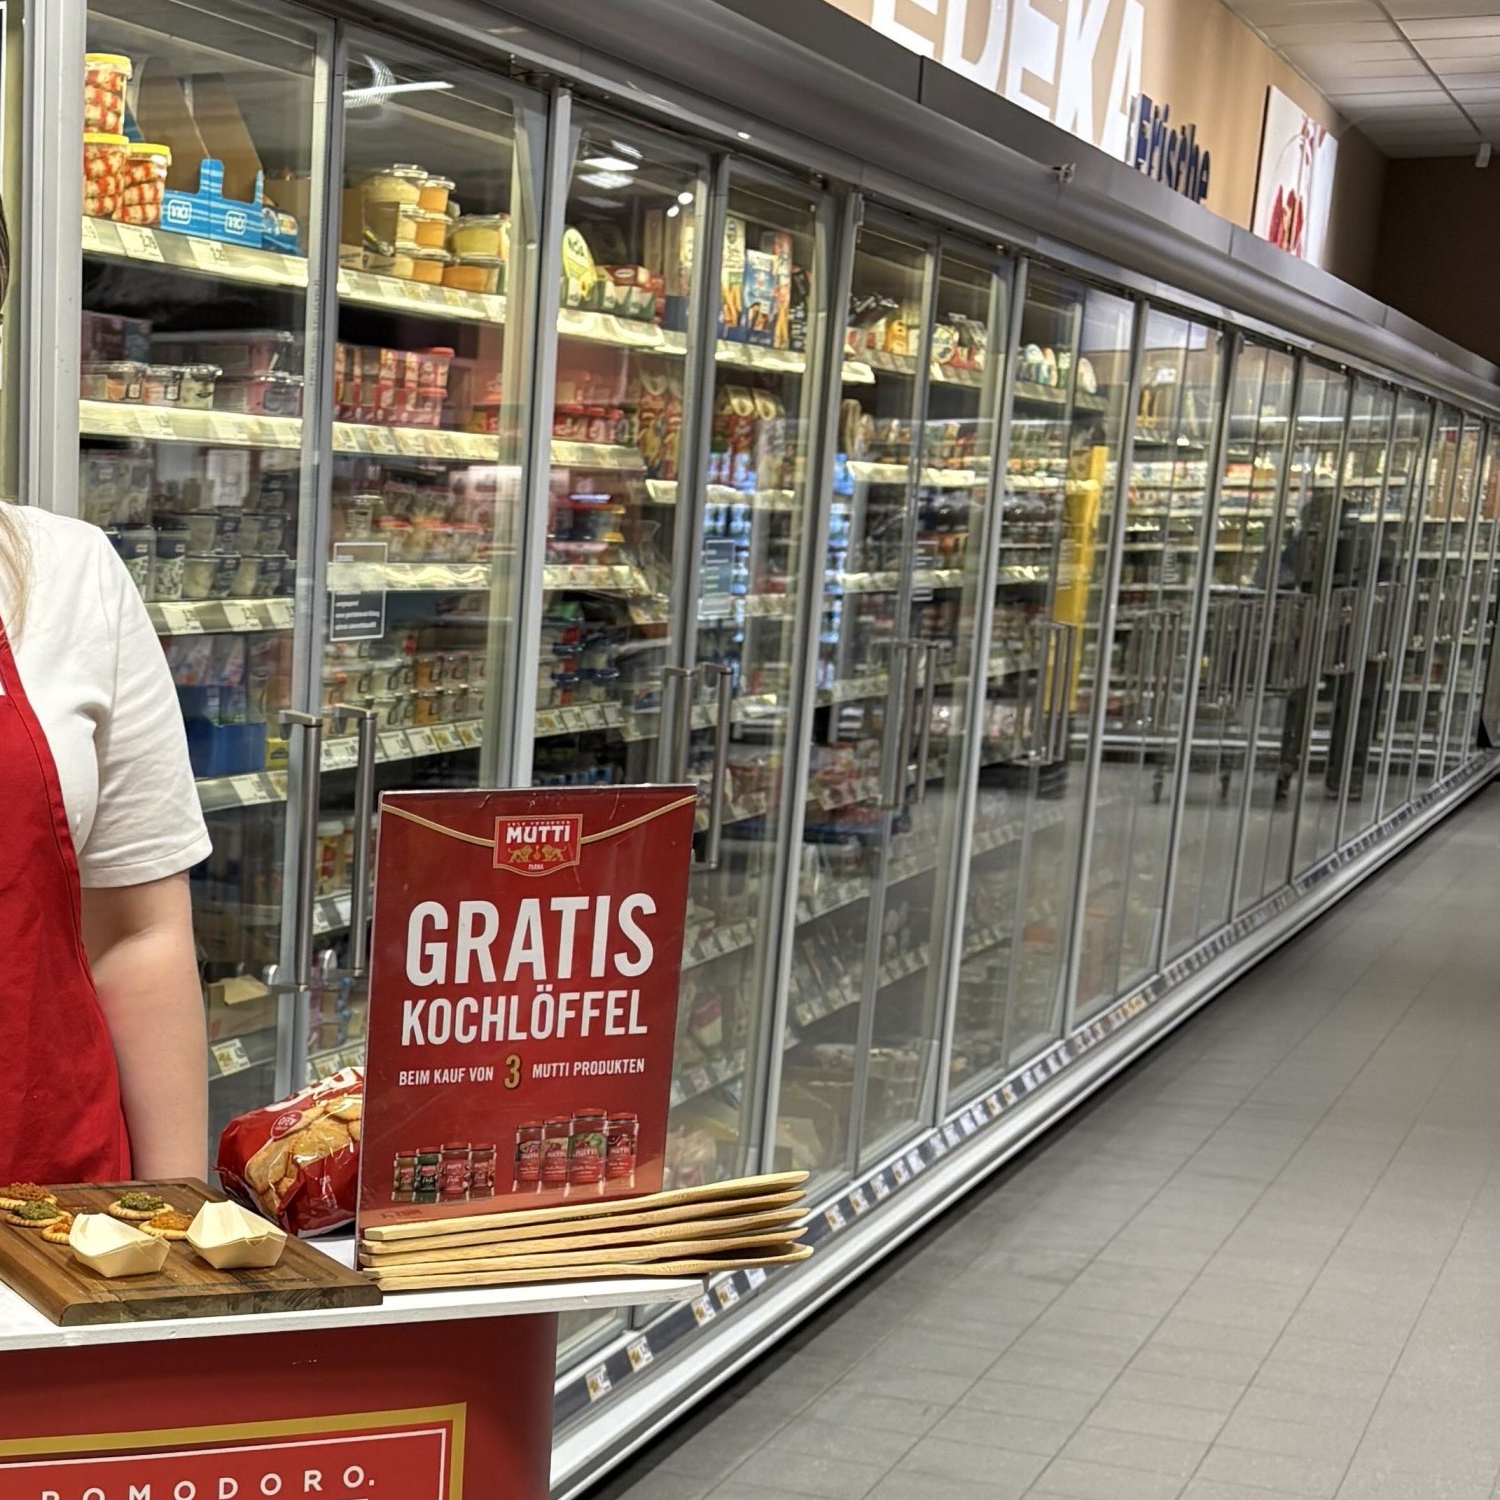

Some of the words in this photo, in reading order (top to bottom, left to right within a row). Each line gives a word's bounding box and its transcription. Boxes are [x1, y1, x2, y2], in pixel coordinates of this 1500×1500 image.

[506, 825, 571, 844] MUTTI
[405, 892, 657, 987] GRATIS
[401, 984, 648, 1047] KOCHLÖFFEL
[399, 1068, 430, 1086] BEIM
[433, 1066, 466, 1085] KAUF
[468, 1065, 494, 1083] VON
[503, 1054, 521, 1090] 3
[532, 1061, 570, 1079] MUTTI
[573, 1057, 645, 1077] PRODUKTEN
